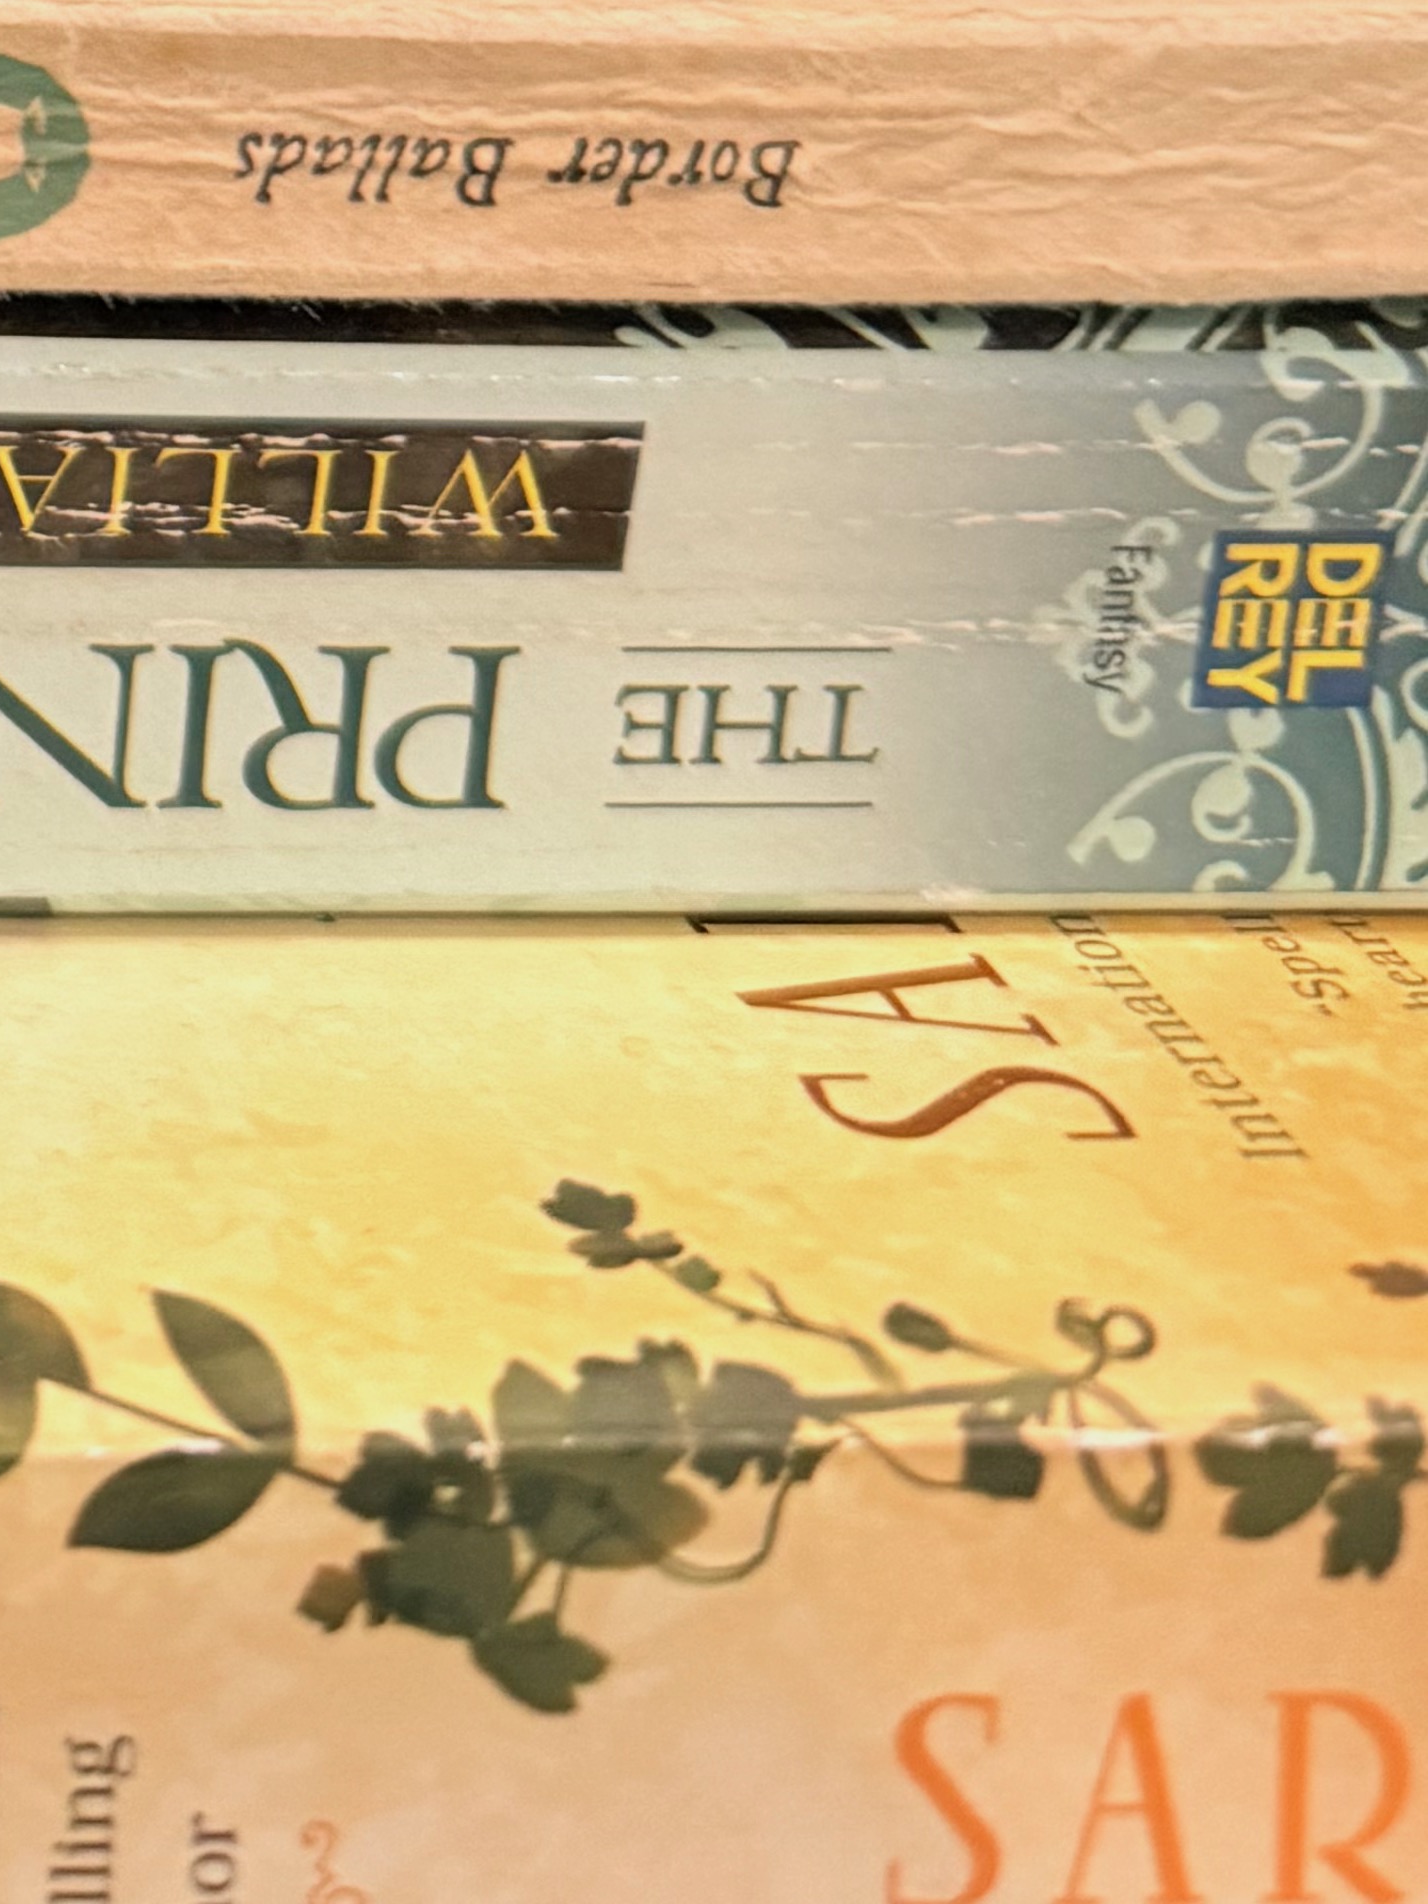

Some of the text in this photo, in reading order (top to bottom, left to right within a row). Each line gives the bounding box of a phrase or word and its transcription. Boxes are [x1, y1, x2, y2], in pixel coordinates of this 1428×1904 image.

[235, 130, 804, 210] Border Ballads
[1206, 541, 1301, 706] REY
[1285, 541, 1384, 703] DEL
[609, 683, 882, 768] THE
[684, 912, 1140, 1141] SA
[1049, 912, 1312, 1160] Internation
[190, 1810, 238, 1904] or
[882, 1686, 1410, 1904] SAR
